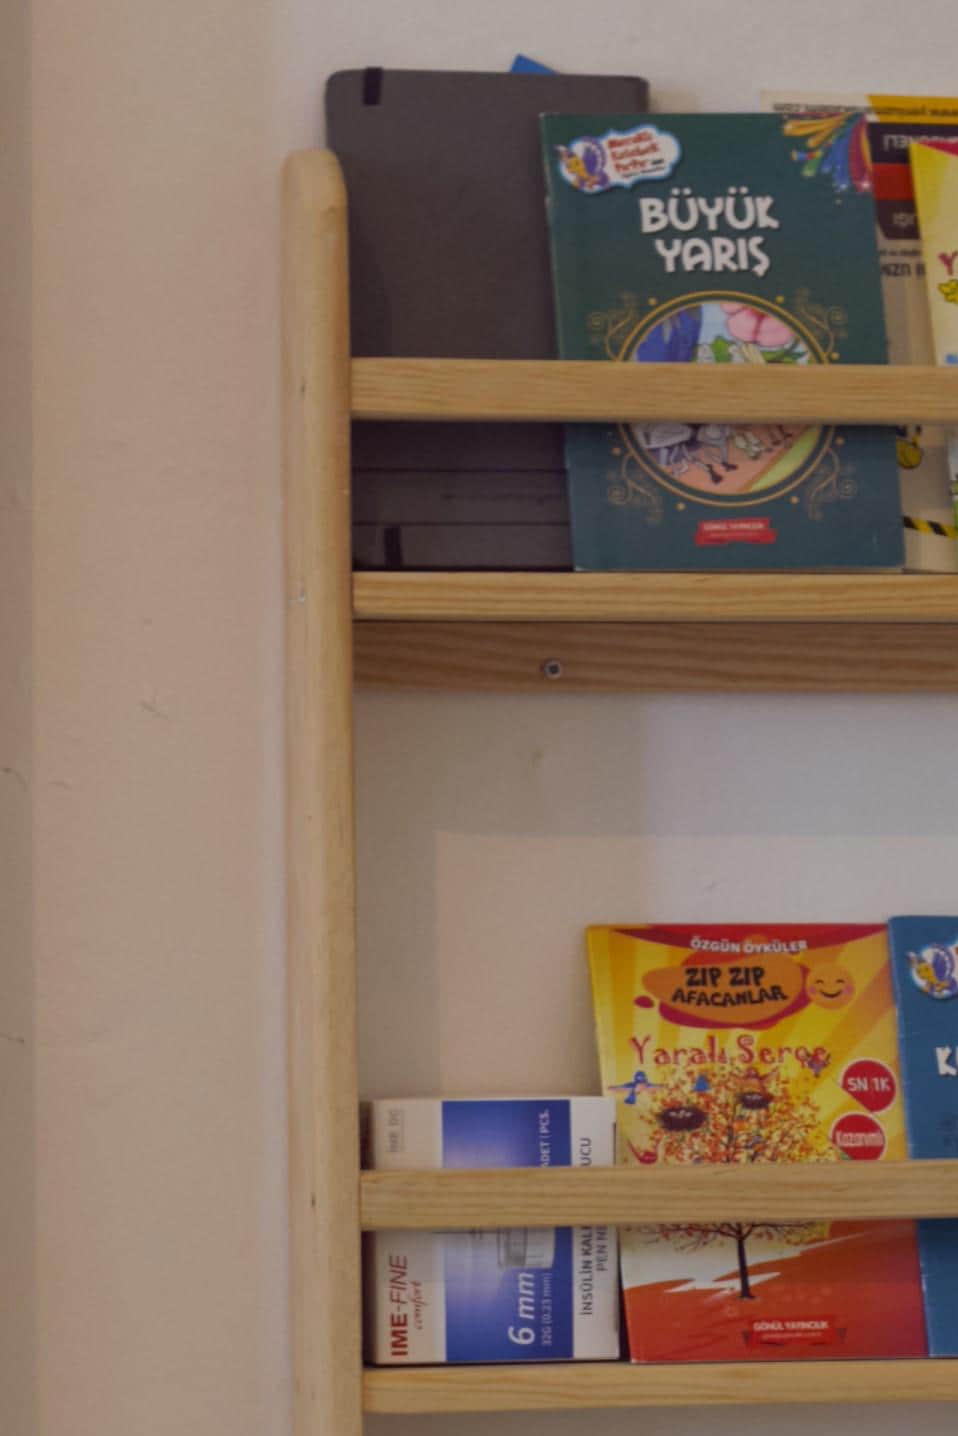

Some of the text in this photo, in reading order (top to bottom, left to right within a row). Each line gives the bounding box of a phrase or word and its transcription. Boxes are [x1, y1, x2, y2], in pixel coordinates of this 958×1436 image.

[639, 187, 779, 233] BÜYÜK
[655, 236, 771, 277] YARIŞ
[690, 936, 741, 953] ÖZGÜN
[685, 966, 765, 987] ZIP ZIP
[671, 985, 789, 1007] AFACANLAR
[629, 1034, 728, 1066] Yaralı
[596, 1245, 608, 1271] PEN
[388, 1254, 409, 1357] IME-FINE
[578, 1260, 593, 1316] İNSÜLİN
[508, 1272, 536, 1346] 6 mm
